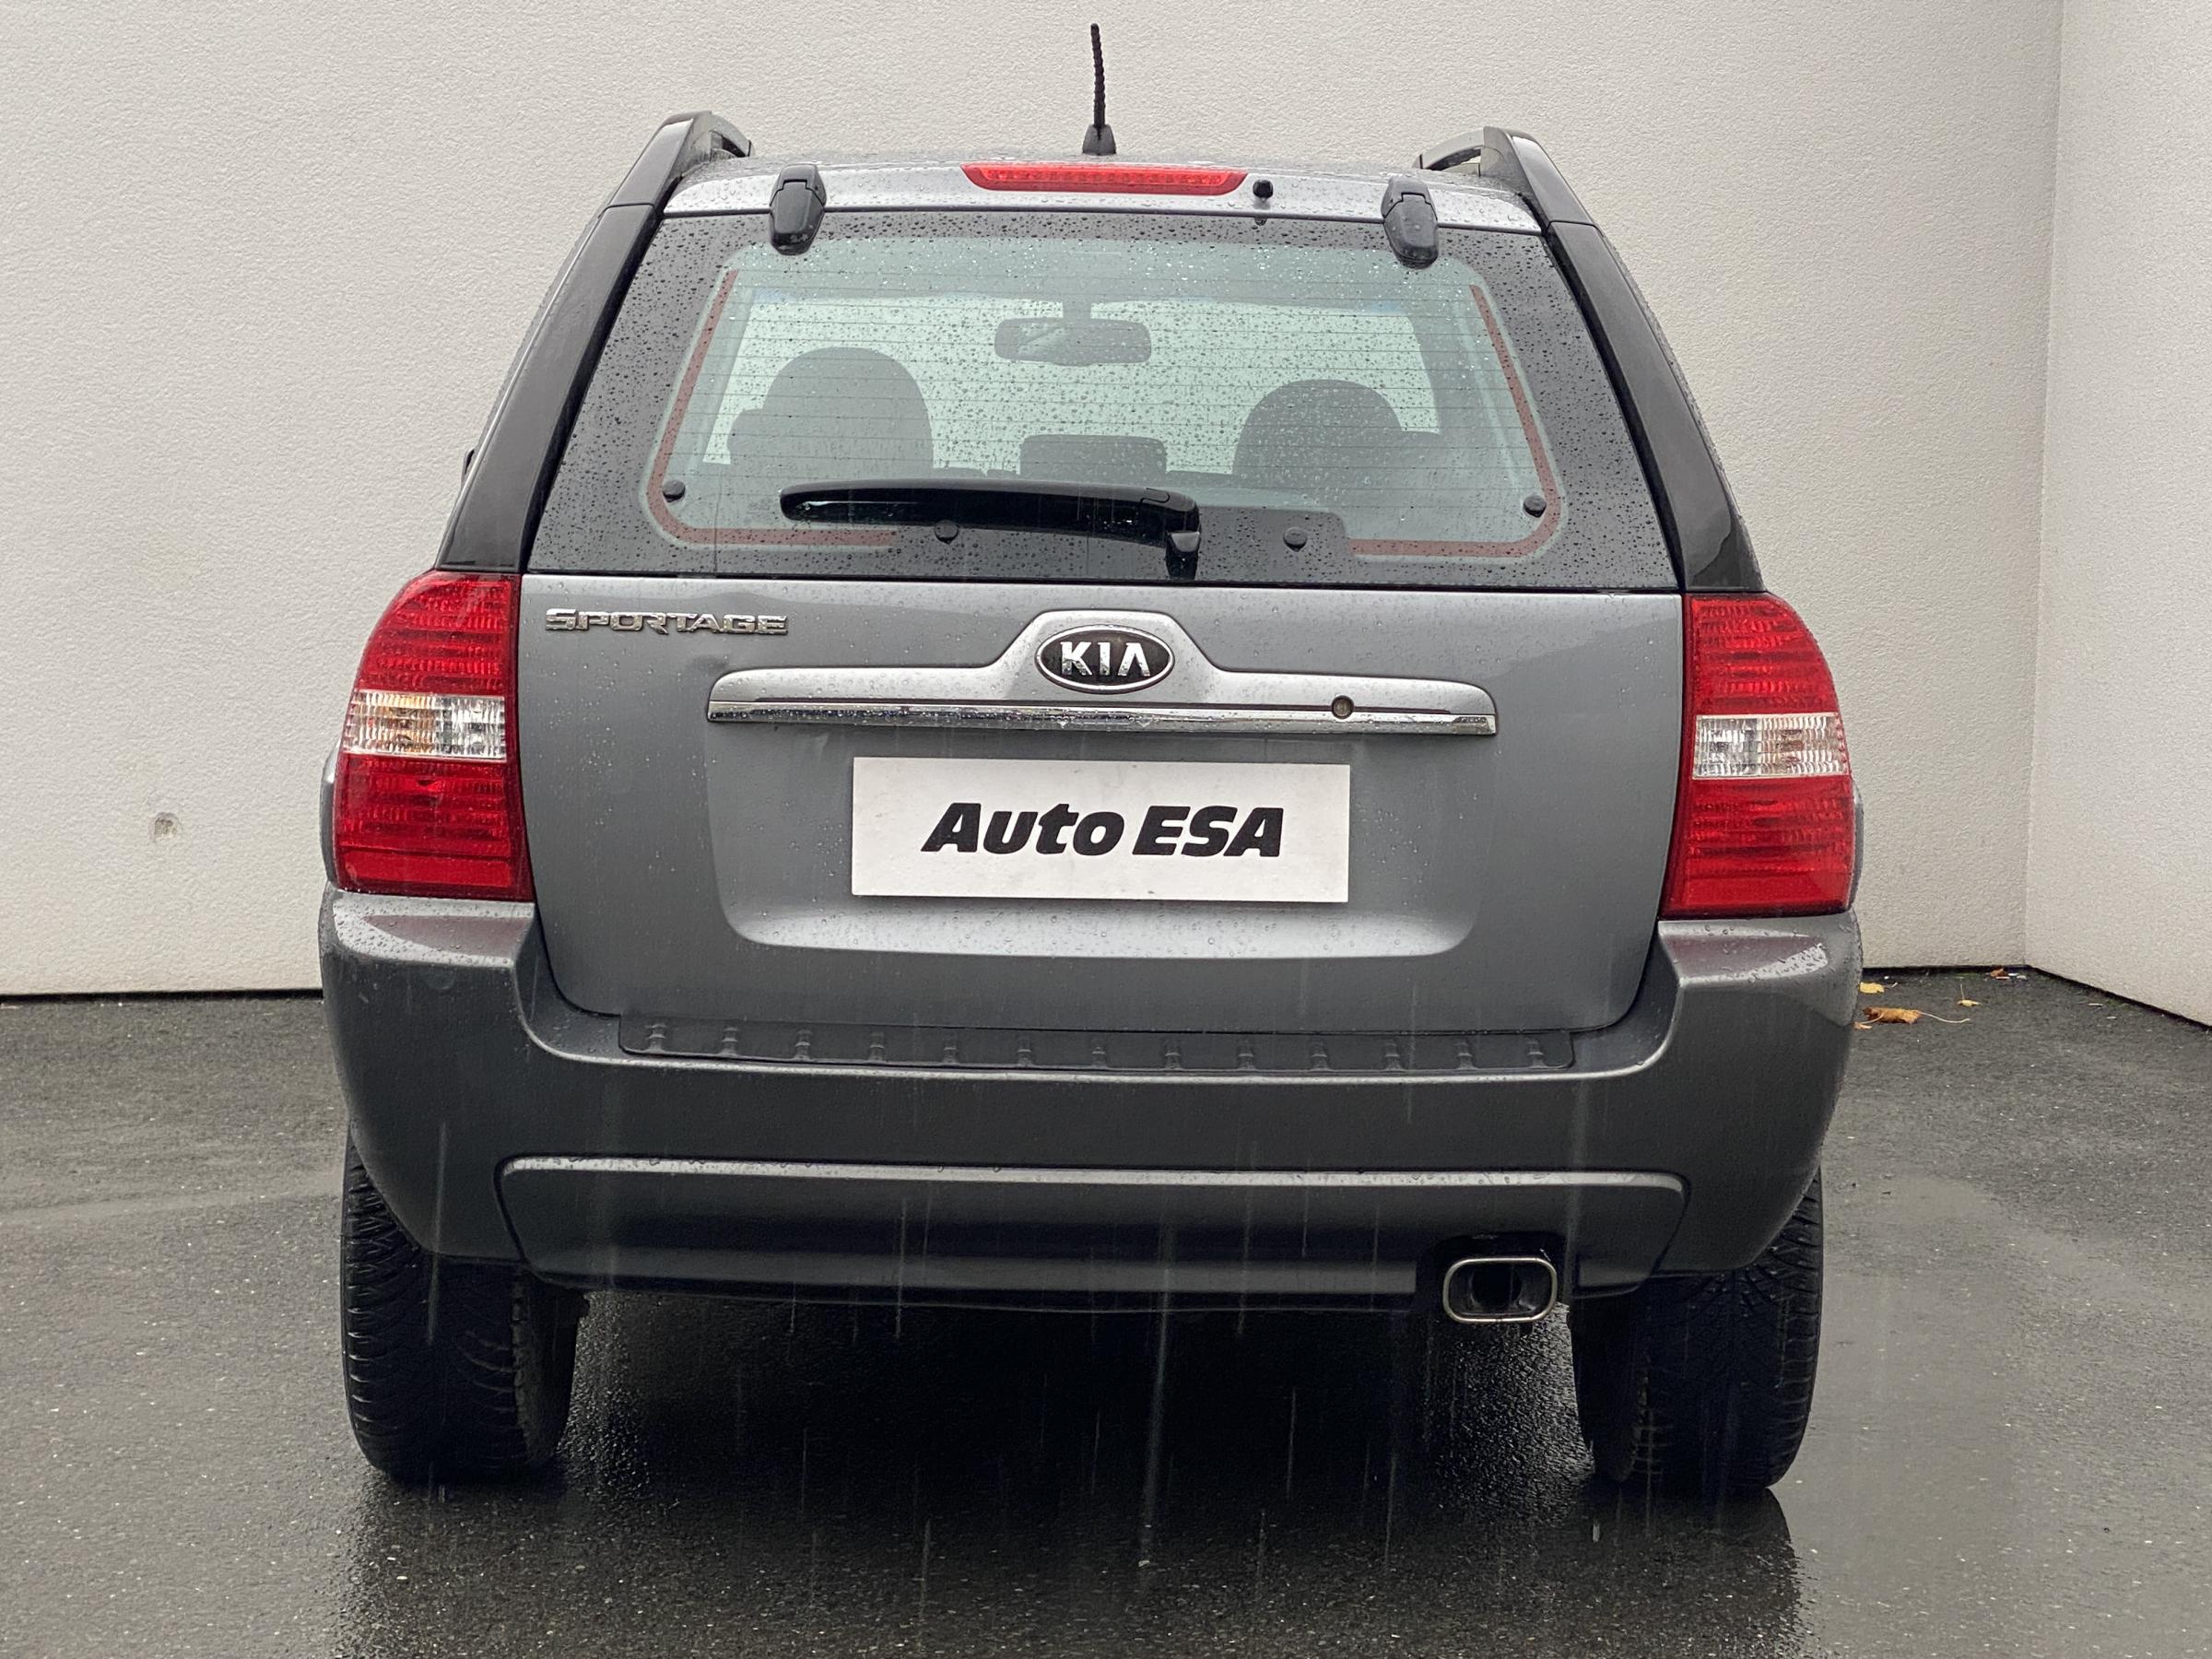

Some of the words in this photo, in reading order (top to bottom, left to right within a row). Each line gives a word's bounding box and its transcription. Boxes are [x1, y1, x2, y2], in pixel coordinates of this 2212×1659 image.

[546, 608, 788, 635] SPORTAGE
[1060, 641, 1151, 677] KIA
[921, 803, 1124, 856] Auto
[1132, 806, 1284, 857] ESA
